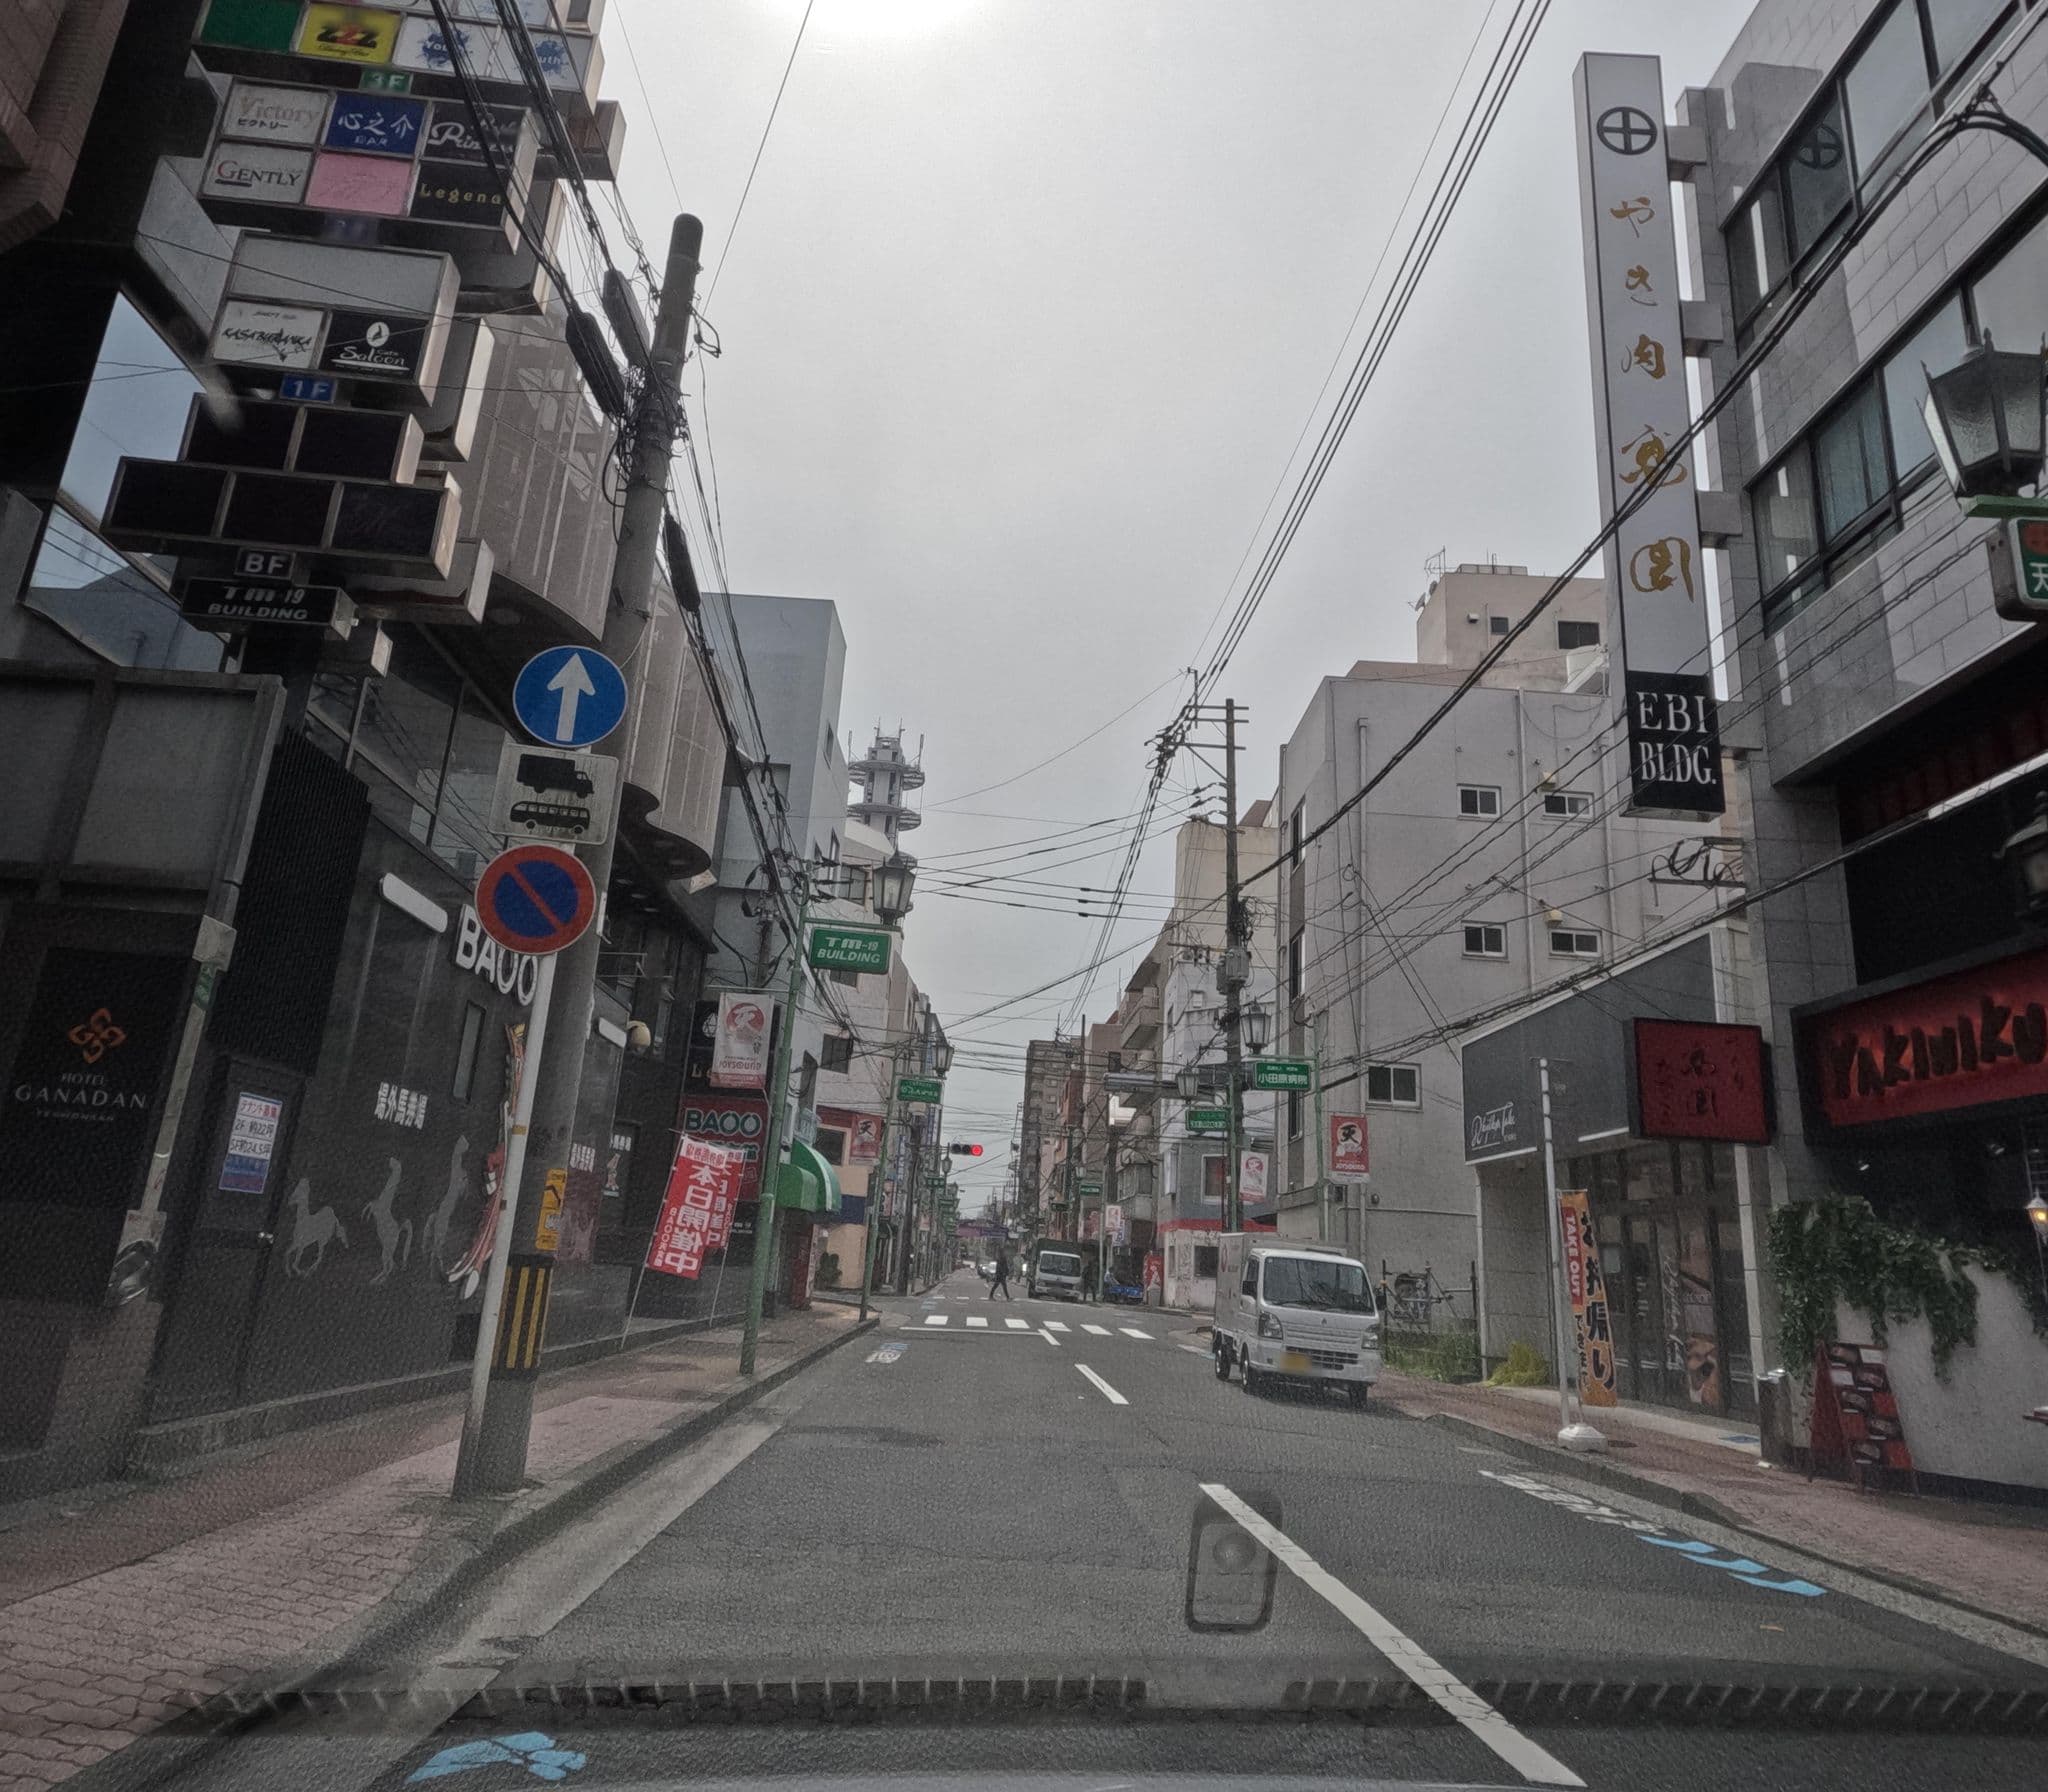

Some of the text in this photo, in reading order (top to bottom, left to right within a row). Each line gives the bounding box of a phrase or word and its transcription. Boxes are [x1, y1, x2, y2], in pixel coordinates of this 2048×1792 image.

[217, 160, 301, 187] GENTLY
[293, 380, 329, 397] 1F
[244, 553, 289, 575] BF
[207, 602, 309, 621] BUILDING
[1636, 691, 1709, 733] EBI
[1638, 741, 1717, 785] BLDG.
[816, 948, 881, 963] BUILDING
[15, 1083, 147, 1109] GANADAN
[685, 1108, 762, 1137] BAOO
[1565, 1215, 1581, 1297] TAKE OUT
